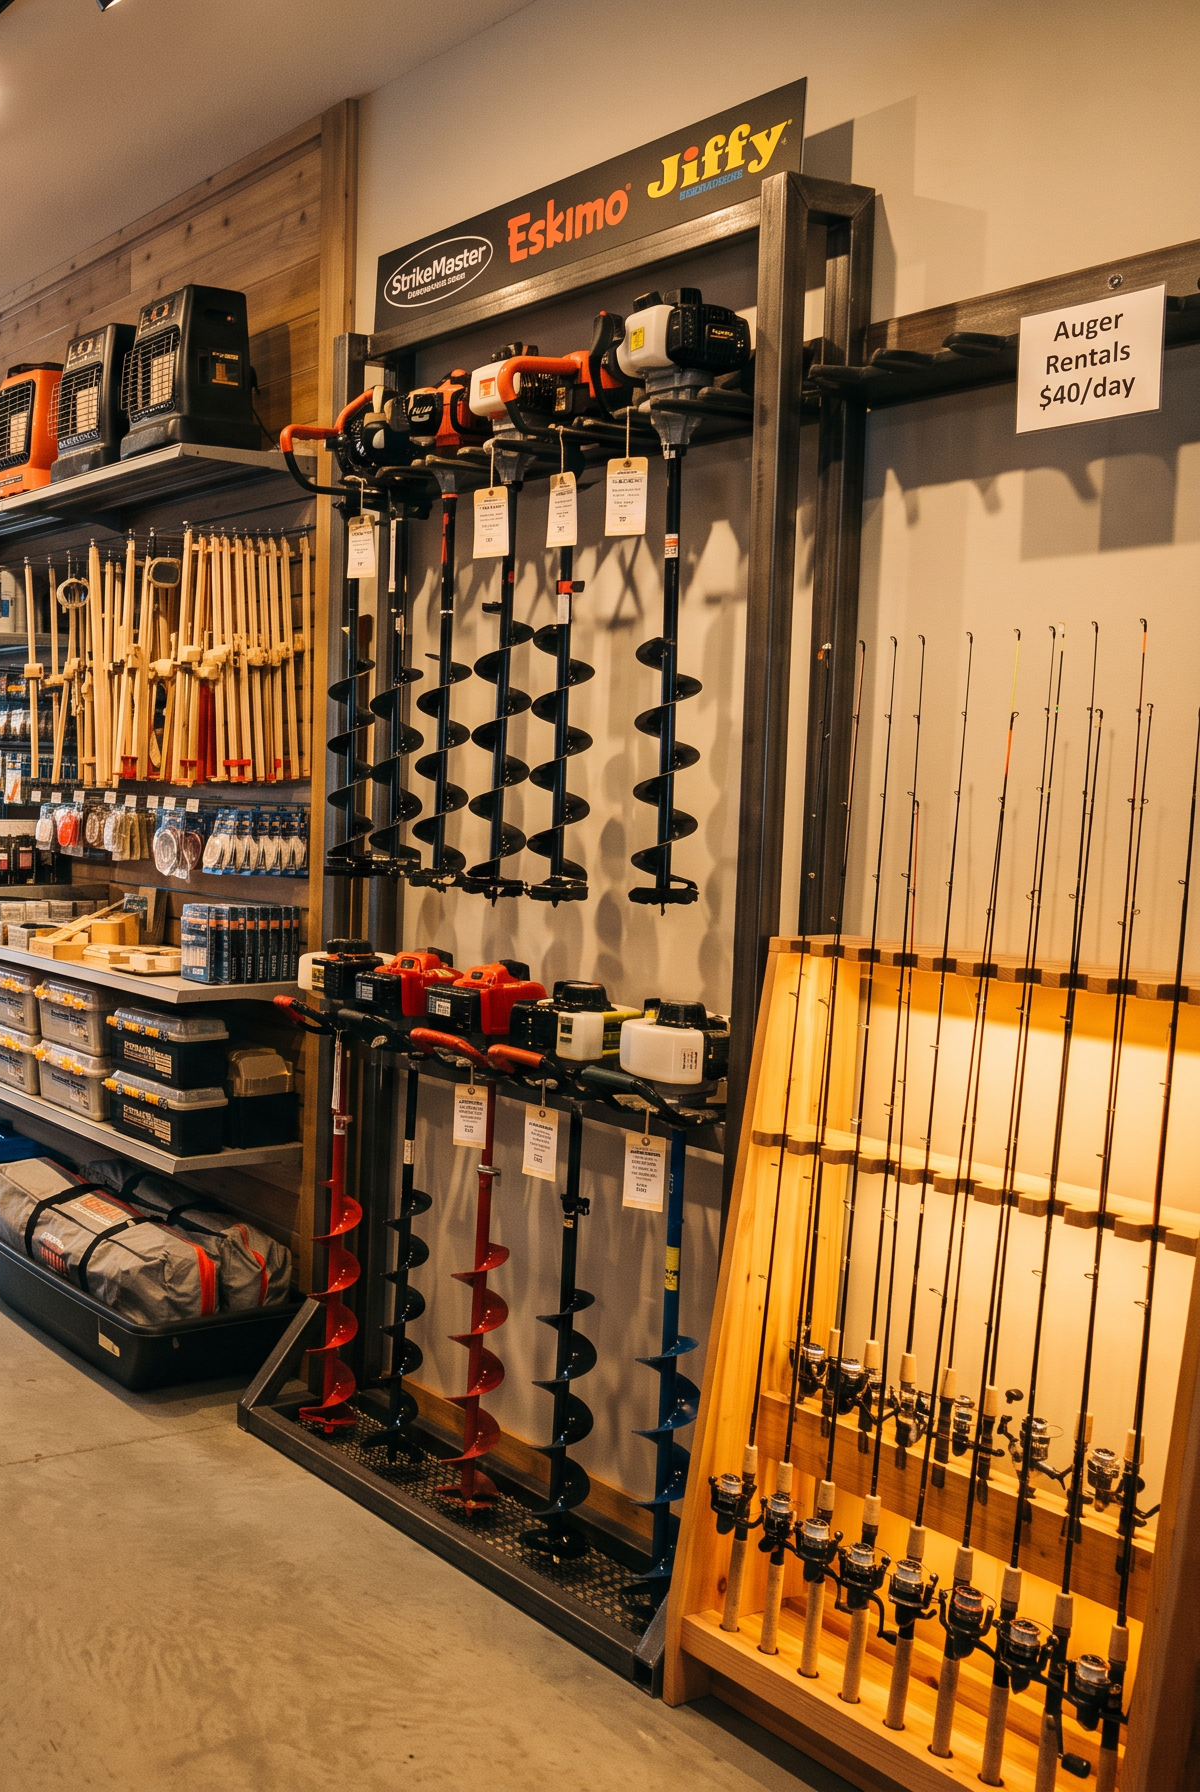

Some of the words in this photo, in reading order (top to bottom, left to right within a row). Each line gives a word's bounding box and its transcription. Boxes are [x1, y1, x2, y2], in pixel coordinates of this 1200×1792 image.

[647, 121, 787, 198] Jiffy
[507, 189, 629, 263] Eskimo
[391, 245, 487, 296] StrikeMaster
[1053, 313, 1123, 341] Auger
[1046, 341, 1131, 375] Rentals
[1039, 376, 1136, 411] $40/day
